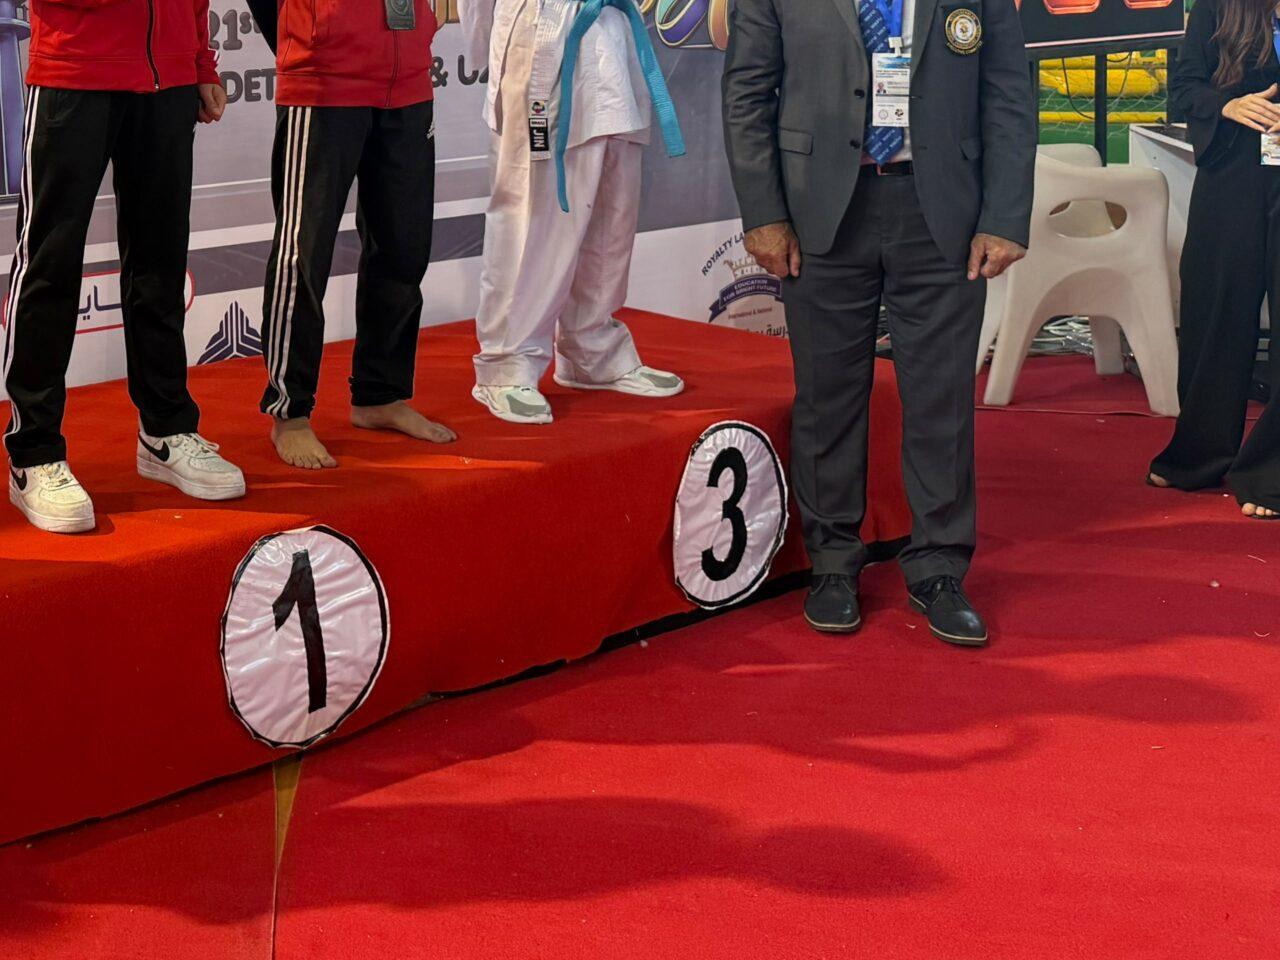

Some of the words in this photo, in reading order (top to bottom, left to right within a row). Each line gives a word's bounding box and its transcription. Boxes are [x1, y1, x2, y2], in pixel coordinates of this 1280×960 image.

[533, 129, 545, 148] JIN
[701, 237, 733, 277] ROYALTY
[734, 231, 745, 244] LA
[701, 446, 748, 582] 3
[272, 550, 328, 715] 1
